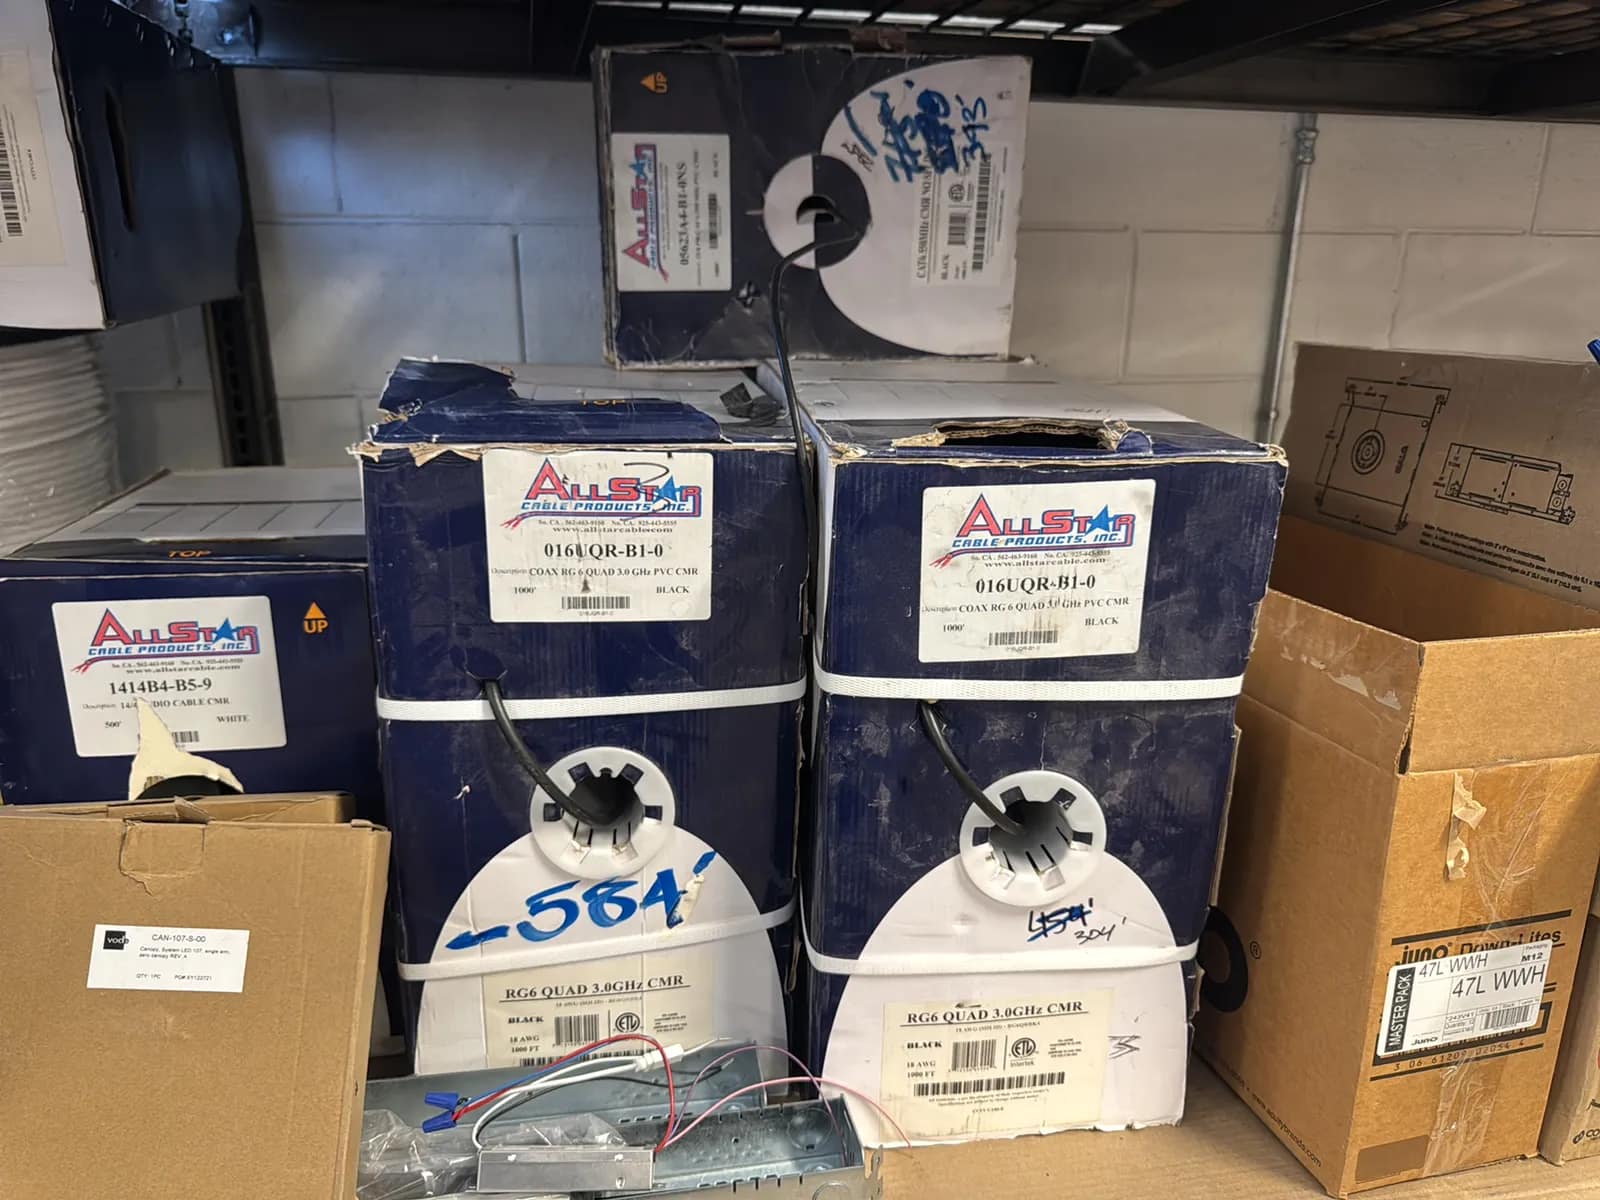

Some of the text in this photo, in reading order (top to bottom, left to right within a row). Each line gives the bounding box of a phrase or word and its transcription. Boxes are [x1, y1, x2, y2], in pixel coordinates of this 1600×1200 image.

[521, 502, 568, 511] CABLE
[952, 538, 1000, 548] CABLE
[168, 549, 213, 559] TOP
[543, 543, 664, 561] 016UQR-B1-0
[529, 567, 559, 577] COAX
[561, 567, 577, 577] RG
[585, 567, 616, 578] QUAD
[616, 567, 631, 577] 3.0
[632, 567, 652, 577] GHz
[653, 567, 674, 577] PVC
[675, 567, 699, 577] CMR
[975, 575, 1096, 593] 016UQR-B1-0
[656, 586, 690, 595] BLACK
[959, 603, 989, 613] COAX
[990, 603, 1006, 612] RG
[1015, 601, 1044, 612] QUAD
[1084, 598, 1104, 608] PVC
[1105, 597, 1129, 607] CMR
[304, 619, 328, 633] UP
[1085, 616, 1119, 626] BLACK
[109, 678, 212, 695] 1414B4-B5-9
[173, 698, 205, 708] CABLE
[207, 697, 230, 706] CMR
[217, 714, 249, 723] WHITE
[151, 933, 206, 943] CAN-107-S-00
[1521, 952, 1544, 963] M12
[1419, 954, 1488, 978] 47L WWH
[1452, 964, 1546, 999] 47L WWH
[506, 987, 537, 999] RG6
[541, 984, 588, 1000] QUAD
[592, 980, 643, 994] 3.0GHz
[647, 975, 684, 988] CMR
[907, 1001, 1083, 1024] RG6 QUAD 3.0GHz CMR
[1388, 974, 1412, 1046] MASTER PACK
[508, 1016, 544, 1024] BLACK
[521, 1035, 540, 1043] AWG
[906, 1040, 943, 1049] BLACK
[918, 1060, 937, 1068] AWG
[1394, 1063, 1400, 1071] 3
[1408, 1059, 1422, 1068] 06
[925, 1070, 936, 1078] FT
